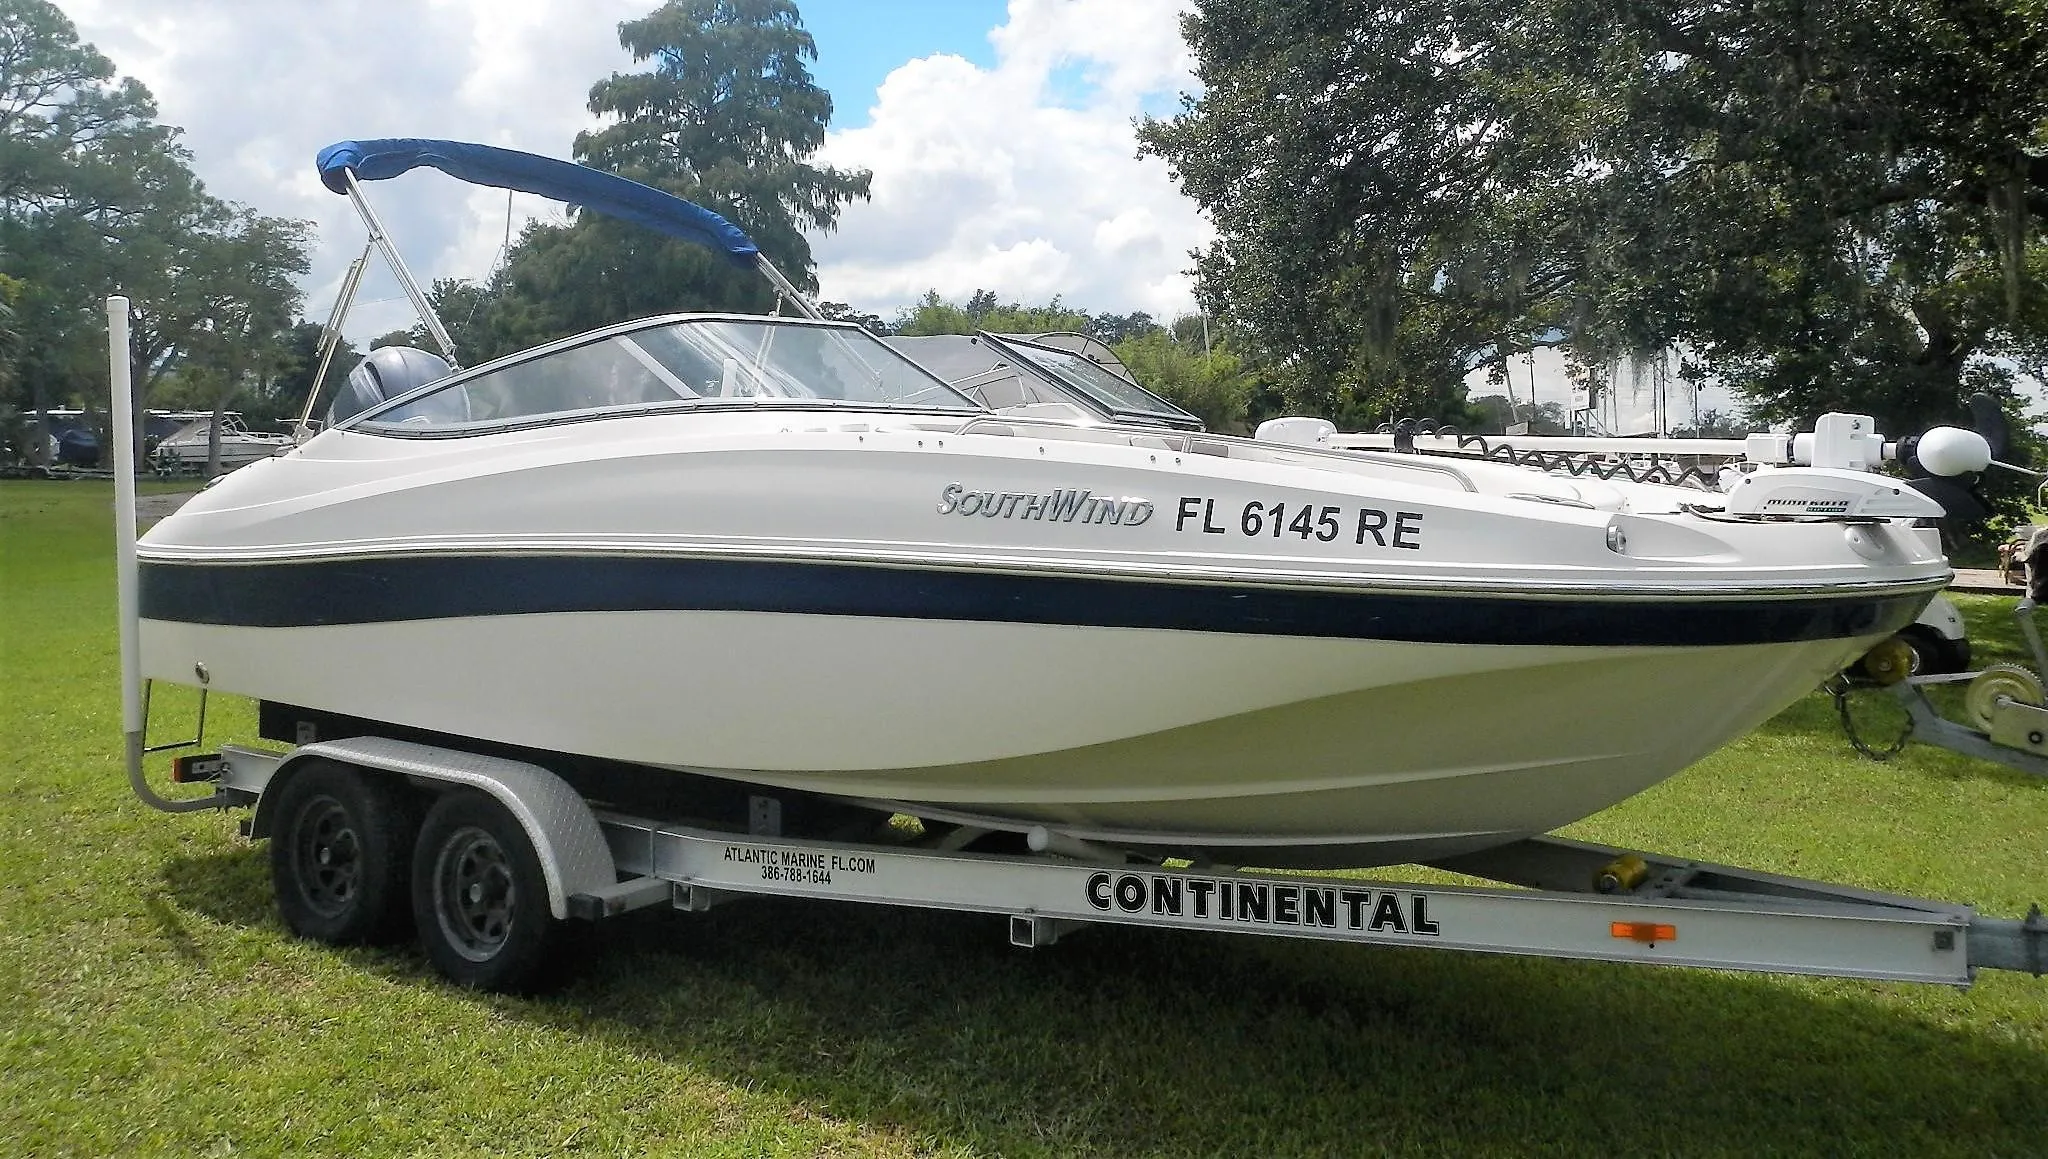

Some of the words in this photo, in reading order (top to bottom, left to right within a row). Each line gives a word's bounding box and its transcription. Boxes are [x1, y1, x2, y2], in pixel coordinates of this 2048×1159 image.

[1175, 497, 1226, 534] FL
[1241, 500, 1340, 542] 6145
[1355, 508, 1424, 550] RE
[724, 847, 778, 864] ATLANTIC
[781, 851, 825, 869] MARINE
[831, 855, 875, 873] FL.COM
[761, 866, 832, 884] 386-788-1644
[1085, 871, 1440, 936] CONTINENTAL
